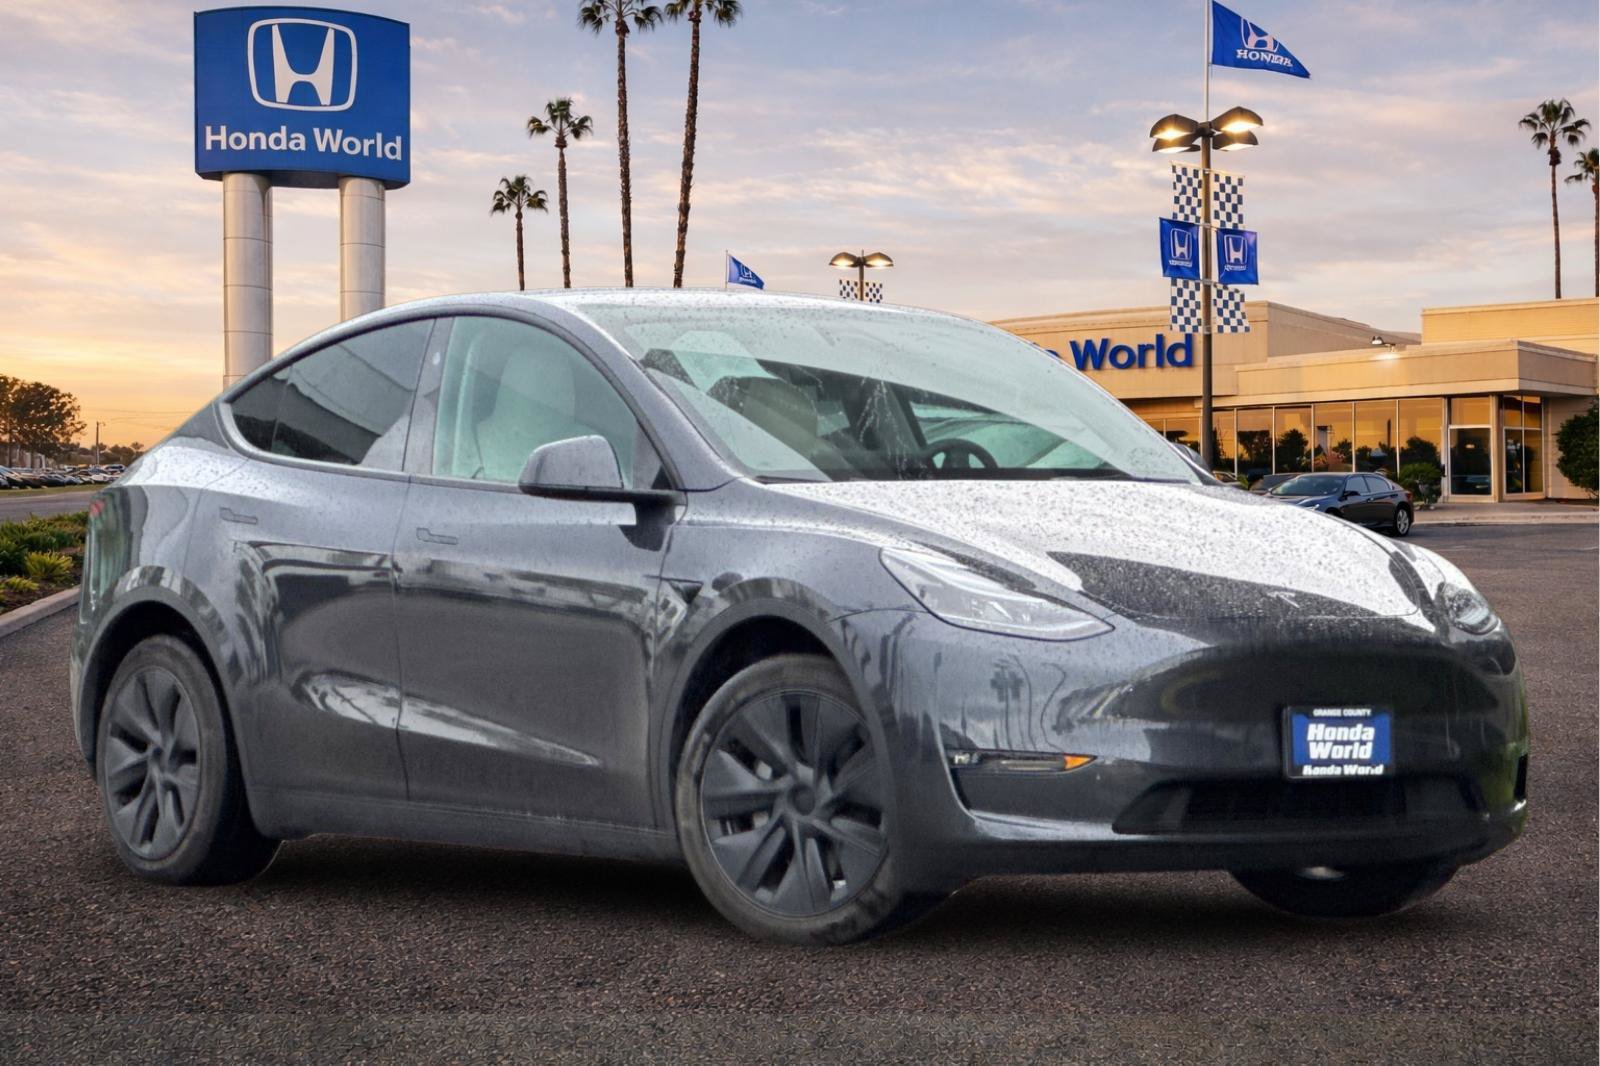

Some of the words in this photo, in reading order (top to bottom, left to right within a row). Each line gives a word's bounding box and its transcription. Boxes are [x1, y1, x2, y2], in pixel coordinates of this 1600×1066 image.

[205, 125, 306, 151] Honda
[313, 128, 402, 161] World
[1069, 333, 1195, 371] World
[1343, 708, 1372, 717] COUNTY
[1307, 723, 1375, 741] Honda
[1309, 742, 1374, 759] World
